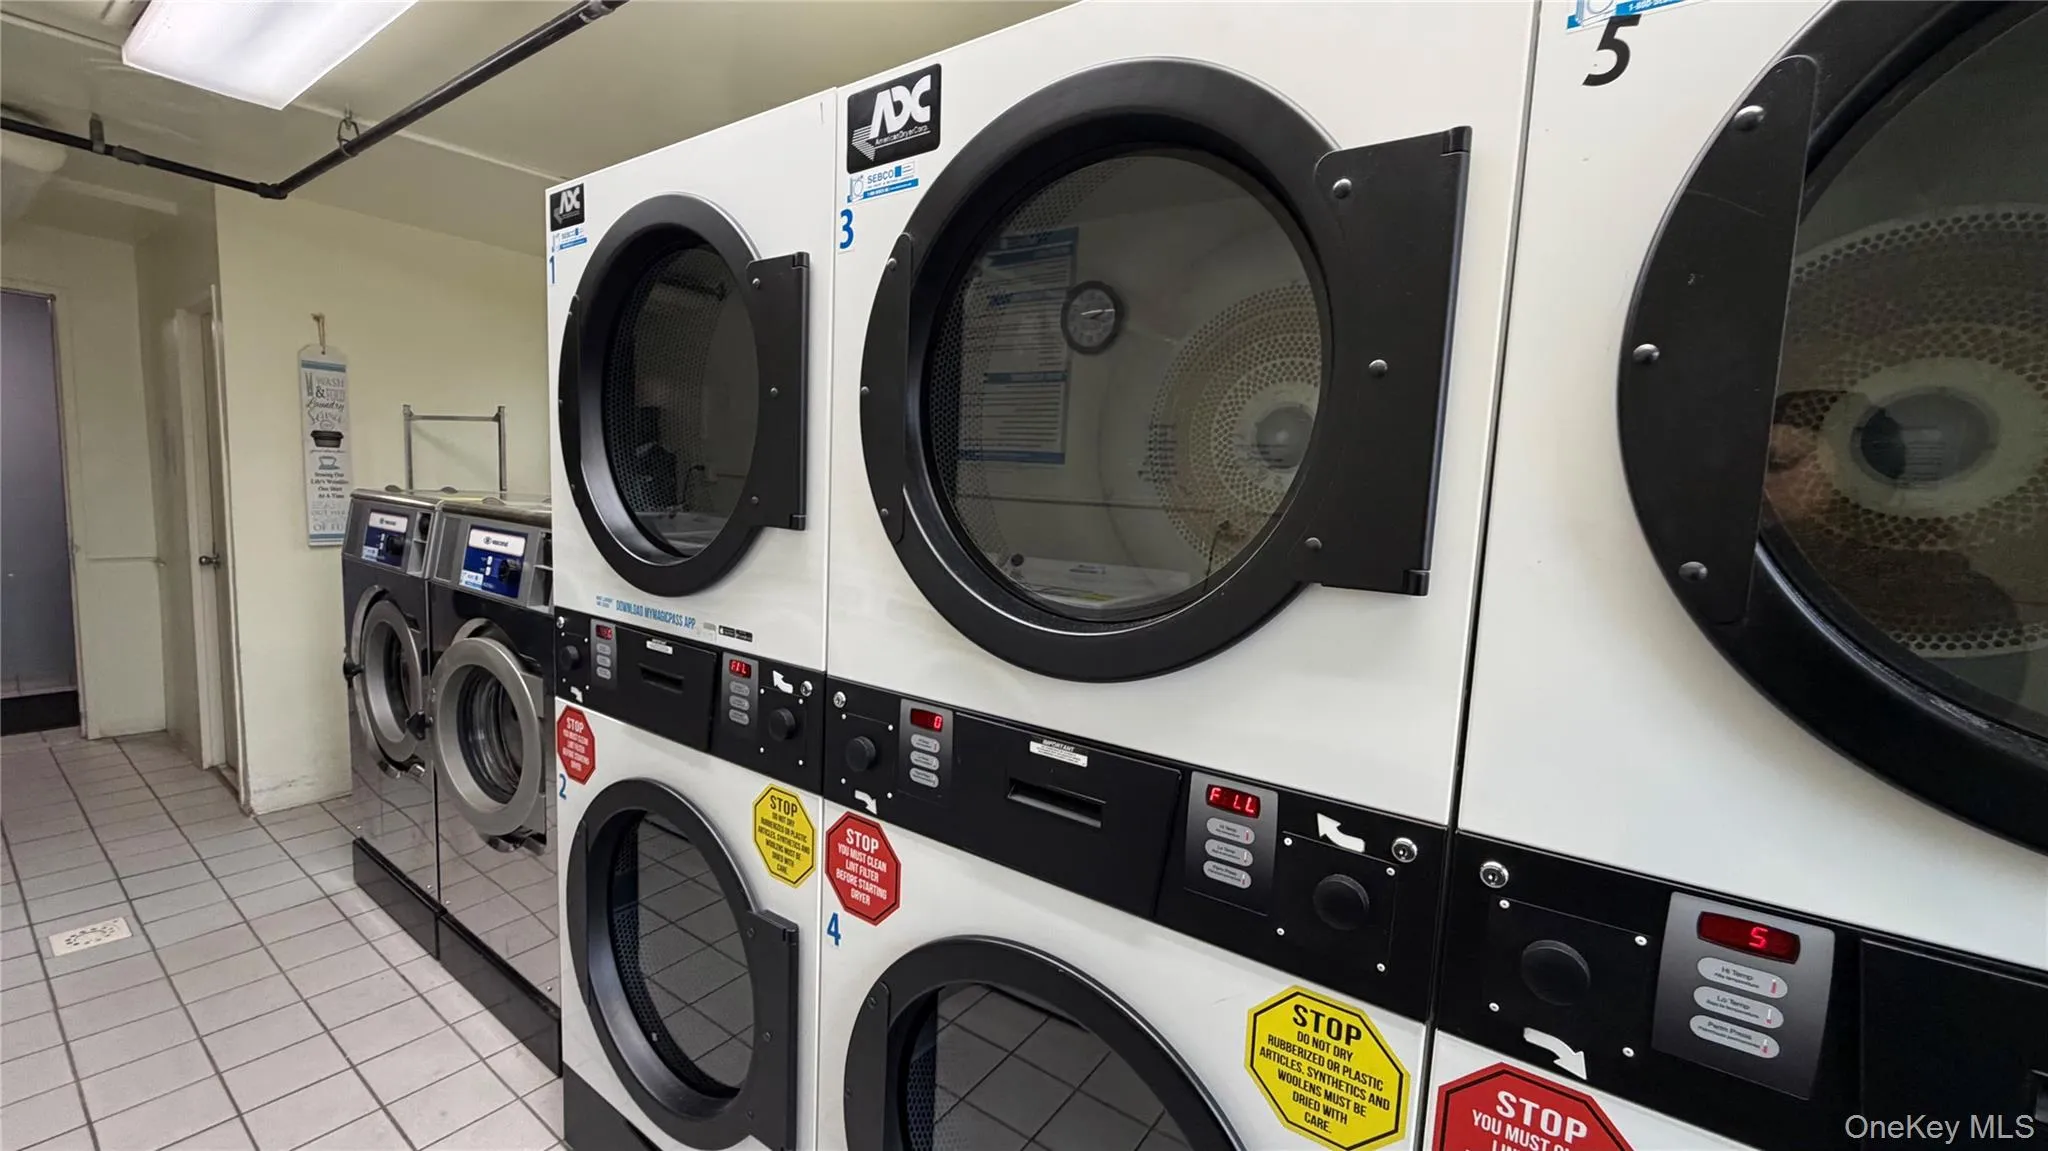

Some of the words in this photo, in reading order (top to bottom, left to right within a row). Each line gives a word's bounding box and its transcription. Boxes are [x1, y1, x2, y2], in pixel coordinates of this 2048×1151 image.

[1582, 14, 1642, 87] 5
[869, 74, 932, 140] ADC
[867, 169, 894, 184] SEBCO
[839, 209, 854, 250] 3
[549, 255, 555, 285] 1
[615, 599, 643, 617] DOWNLOAD
[684, 615, 697, 629] APP
[566, 716, 585, 734] STOP
[559, 773, 566, 800] 2
[770, 794, 798, 817] STOP
[846, 828, 879, 854] STOP
[837, 842, 850, 857] YOU
[850, 847, 867, 864] MUST
[867, 855, 887, 873] CLEAN
[845, 859, 859, 874] LINT
[859, 865, 879, 883] FILTER
[836, 867, 858, 887] BEFORE
[859, 878, 888, 901] STARTING
[850, 887, 871, 906] DRYER
[827, 912, 841, 947] 4
[1732, 968, 1754, 981] Temp
[1717, 995, 1728, 1003] Lo
[1730, 999, 1751, 1010] Temp
[1292, 1004, 1362, 1046] STOP
[1707, 1020, 1729, 1032] Perm
[1297, 1031, 1310, 1045] DO
[1312, 1036, 1331, 1053] NOT
[1333, 1045, 1354, 1062] DRY
[1267, 1033, 1325, 1067] RUBBERIZED
[1327, 1060, 1341, 1074] OR
[1342, 1065, 1384, 1092] PLASTIC
[1259, 1046, 1305, 1075] ARTICLES.
[1307, 1066, 1367, 1101] SYNTHETICS
[1368, 1093, 1390, 1111] AND
[1277, 1068, 1322, 1098] WOOLENS
[1323, 1089, 1352, 1110] MUST
[1353, 1102, 1367, 1118] BE
[1292, 1091, 1321, 1113] DRIED
[1322, 1103, 1348, 1125] WITH
[1304, 1111, 1332, 1134] CARE.
[1495, 1090, 1588, 1144] STOP
[1472, 1108, 1502, 1136] YOU
[1504, 1123, 1551, 1151] MUST
